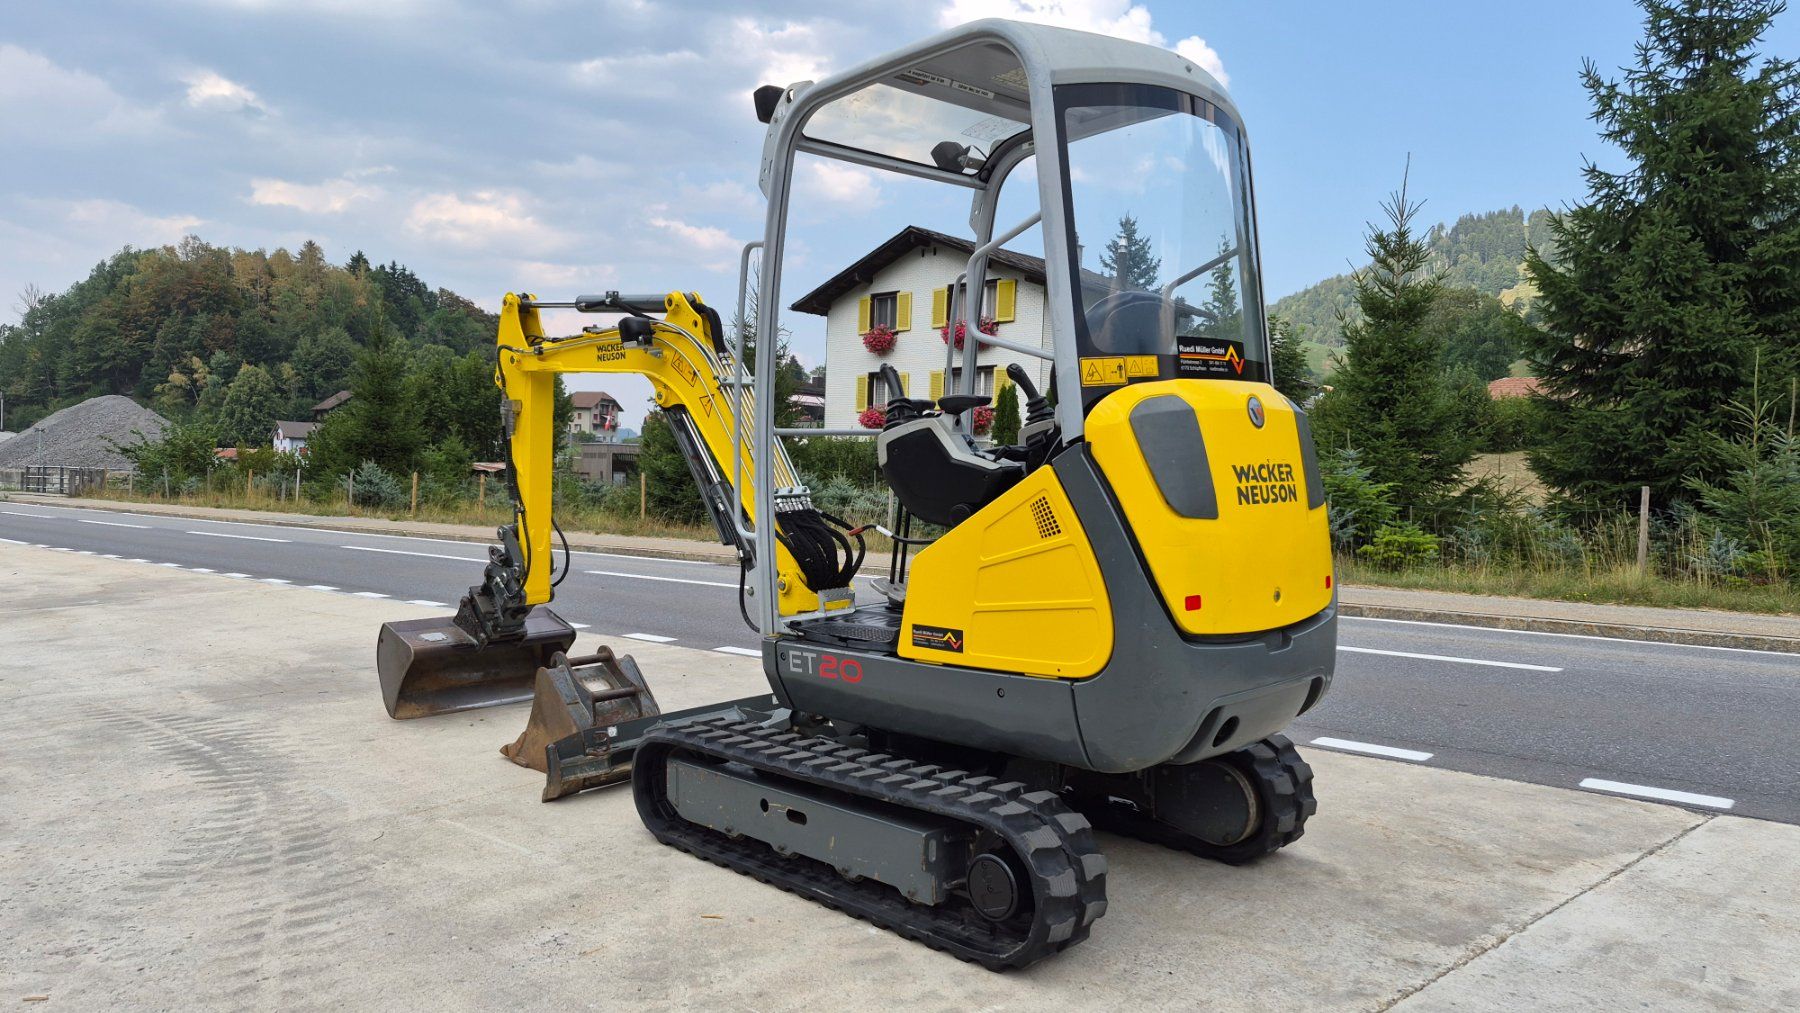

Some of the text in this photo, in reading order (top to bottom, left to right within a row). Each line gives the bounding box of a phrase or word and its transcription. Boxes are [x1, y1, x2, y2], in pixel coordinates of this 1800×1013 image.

[596, 351, 626, 362] NEUSON
[1231, 463, 1295, 484] WACKER
[1236, 484, 1298, 506] NEUSON
